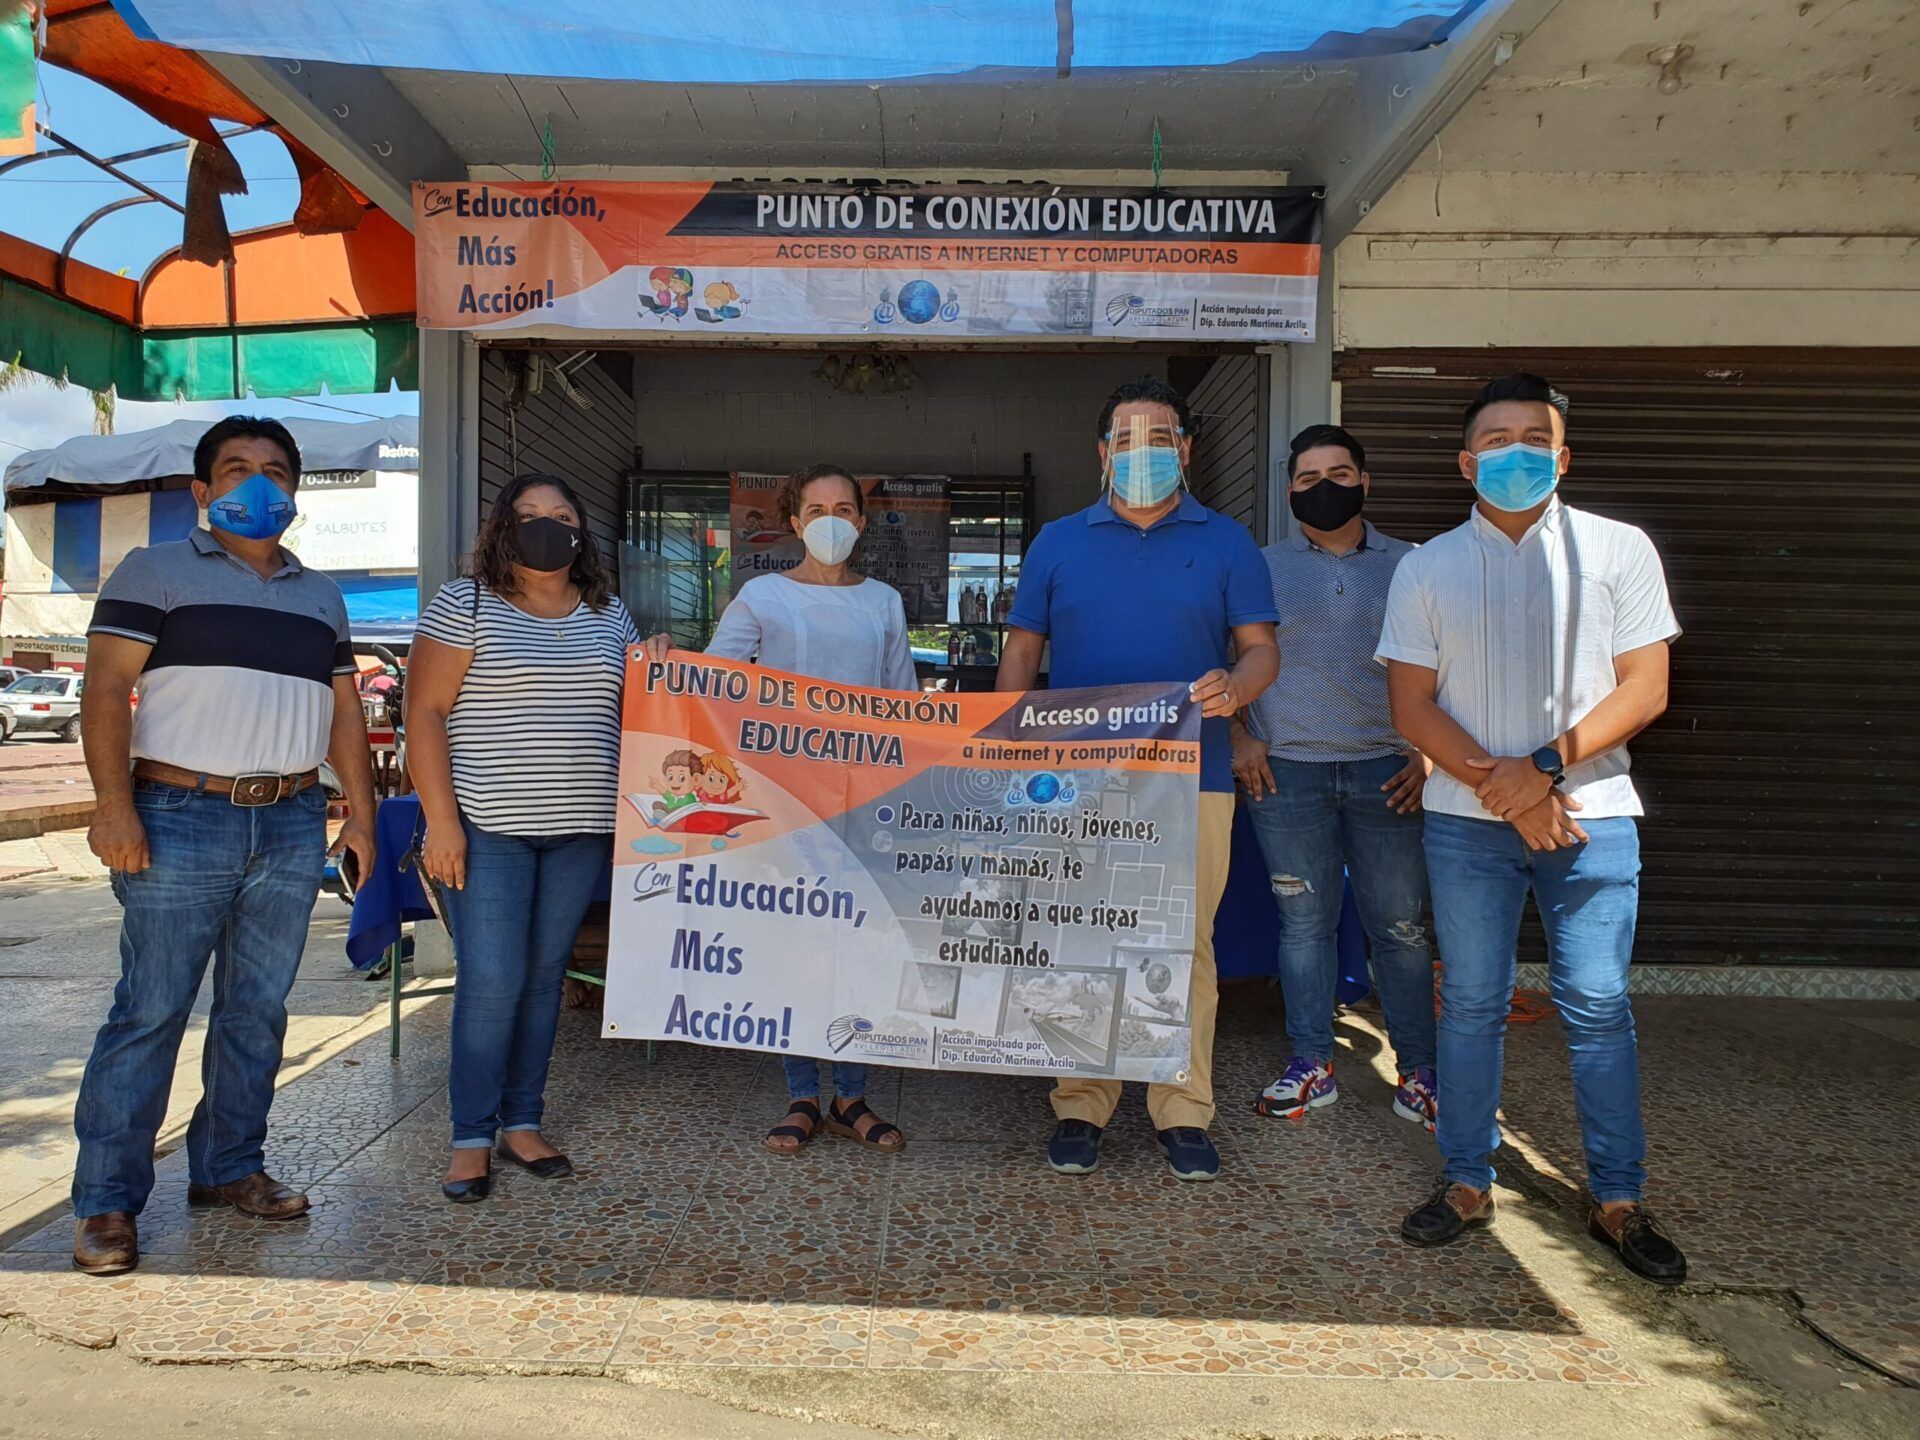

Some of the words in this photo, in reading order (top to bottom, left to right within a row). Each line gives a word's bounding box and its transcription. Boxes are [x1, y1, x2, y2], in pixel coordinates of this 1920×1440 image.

[424, 188, 452, 212] Con
[456, 186, 606, 222] Educación,
[757, 194, 863, 228] PUNTO
[875, 196, 914, 229] DE
[925, 187, 1089, 231] CONEXIÓN
[1102, 198, 1277, 234] EDUCATIVA
[457, 235, 517, 266] Más
[776, 243, 857, 260] ACCESO
[862, 244, 932, 261] GRATIS
[936, 245, 952, 261] A
[955, 245, 1049, 262] INTERNET
[1056, 246, 1068, 262] Y
[1073, 247, 1239, 265] COMPUTADORAS
[458, 279, 554, 314] Acción!
[1129, 307, 1174, 315] DIPUTADOS
[1200, 304, 1224, 314] Acción
[1226, 305, 1265, 315] impulsada
[1267, 308, 1282, 316] por:
[1200, 317, 1215, 328] Dip.
[1217, 317, 1248, 328] Eduardo
[1250, 319, 1282, 329] Martínez
[1284, 320, 1307, 329] Arcila
[738, 476, 778, 489] PUNTO
[883, 480, 914, 492] Acceso
[916, 482, 943, 495] gratis
[314, 521, 387, 535] SALBUTES
[14, 642, 59, 651] IMPORTACIONES
[60, 643, 88, 655] ESMERAL
[646, 661, 749, 702] PUNTO
[758, 674, 797, 709] DE
[806, 685, 960, 726] CONEXIÓN
[1020, 704, 1100, 728] Acceso
[1107, 700, 1179, 732] gratis
[739, 718, 905, 768] EDUCATIVA
[962, 745, 973, 759] a
[980, 742, 1050, 761] internet
[1055, 748, 1065, 764] y
[1070, 741, 1198, 764] computadoras
[900, 802, 944, 830] Para
[951, 807, 1009, 836] niñas,
[1017, 808, 1075, 839] niños,
[1080, 810, 1161, 845] jóvenes,
[895, 846, 955, 873] papás
[961, 855, 975, 877] y
[980, 850, 1054, 882] mamás,
[1062, 855, 1083, 880] te
[634, 862, 671, 893] Con
[676, 863, 867, 928] Educación,
[920, 891, 1022, 922] ayudamos
[1027, 902, 1040, 922] a
[1047, 902, 1083, 927] que
[1091, 900, 1139, 933] sigas
[670, 929, 743, 975] Más
[939, 938, 1055, 968] estudiando.
[663, 994, 792, 1048] Acción!
[854, 1032, 907, 1044] DIPUTADOS
[909, 1037, 928, 1046] PAN
[870, 1045, 927, 1054] LEGISLATURA
[942, 1033, 971, 1046] Acción
[974, 1037, 1023, 1050] impulsada
[1026, 1041, 1045, 1052] por:
[941, 1049, 960, 1063] Dip.
[963, 1051, 1002, 1065] Eduardo
[1048, 1056, 1075, 1069] Arcila
